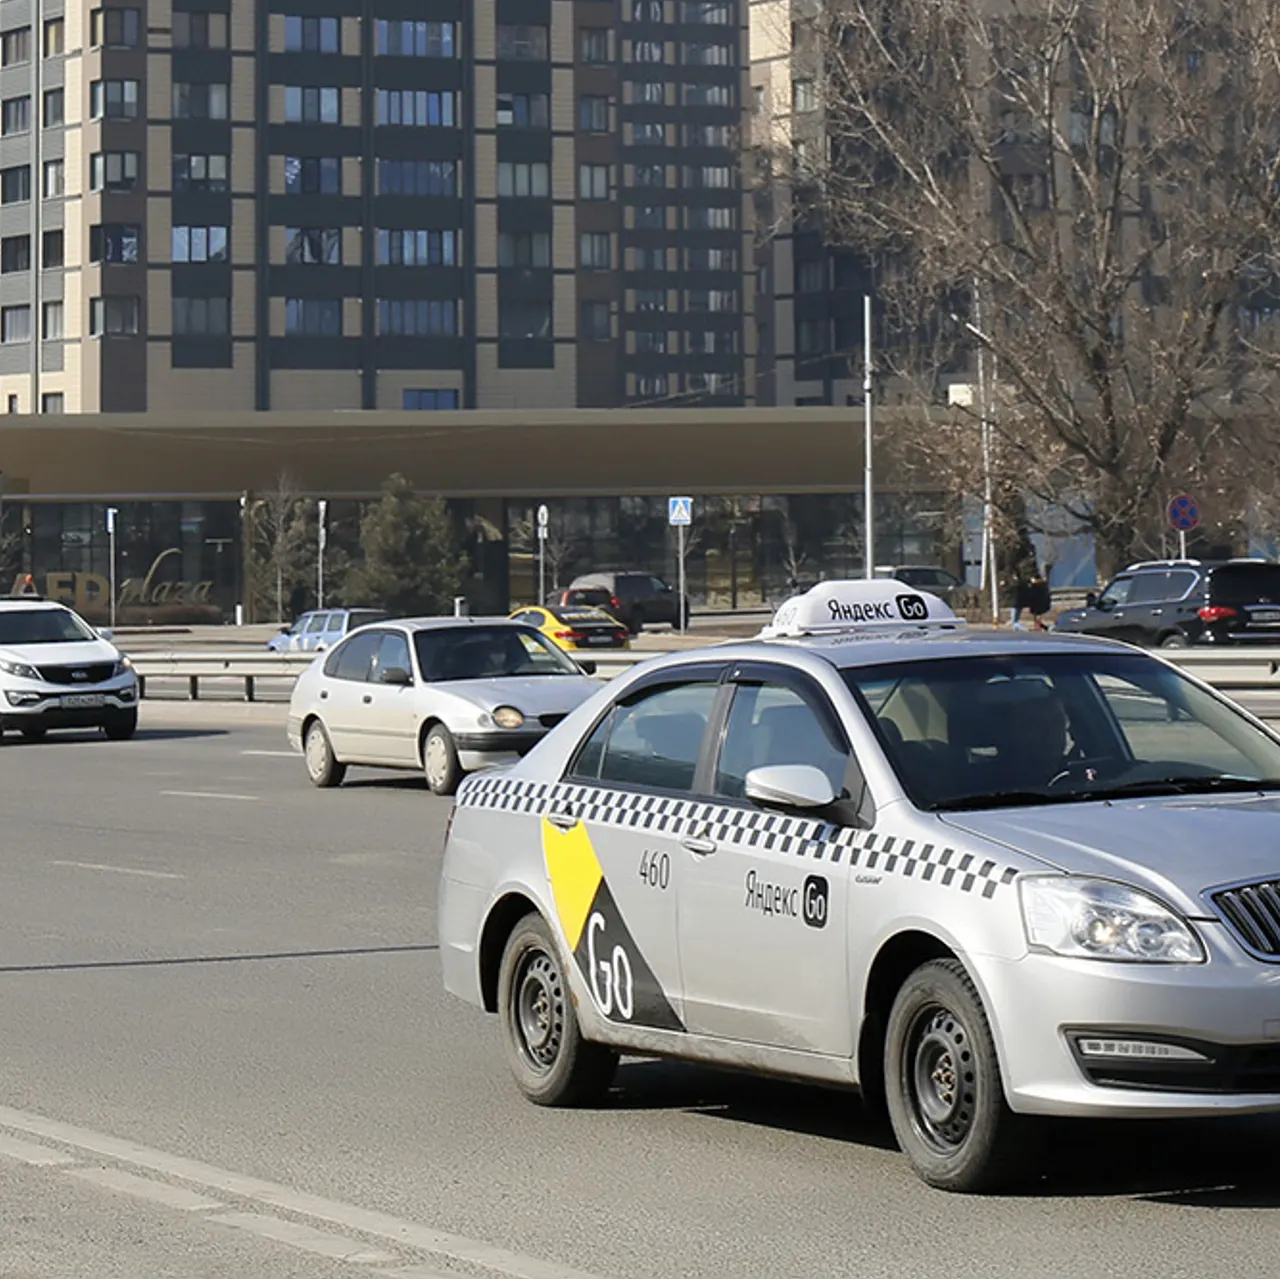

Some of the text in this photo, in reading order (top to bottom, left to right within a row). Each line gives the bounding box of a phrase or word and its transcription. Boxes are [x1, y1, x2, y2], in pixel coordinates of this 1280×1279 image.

[118, 547, 215, 605] plaza
[827, 597, 924, 622] Яндекс Go
[639, 849, 671, 890] 460
[745, 870, 826, 921] Яндекс Go
[588, 912, 634, 1020] Go
